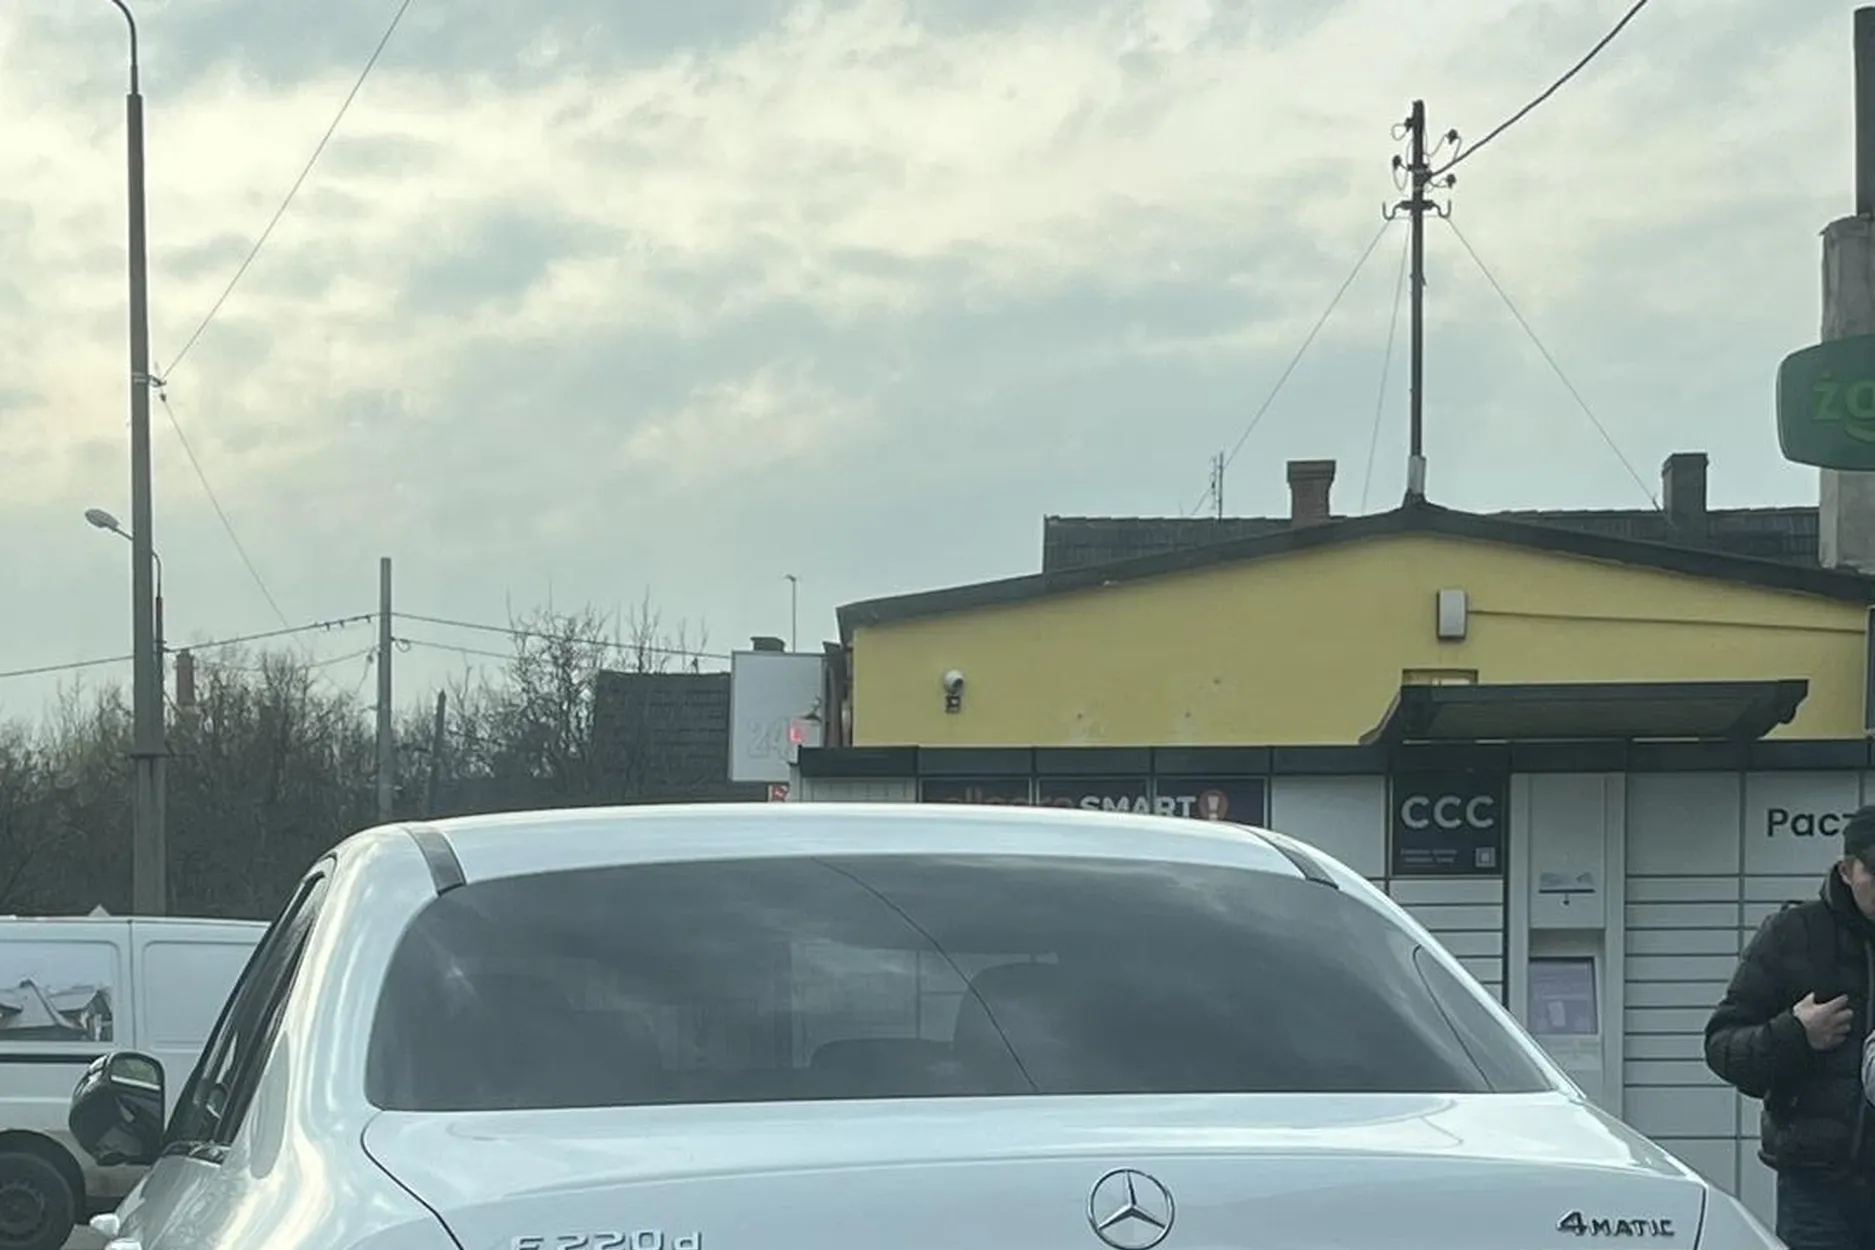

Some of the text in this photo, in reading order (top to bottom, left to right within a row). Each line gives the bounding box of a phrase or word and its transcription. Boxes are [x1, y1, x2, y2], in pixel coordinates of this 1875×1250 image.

[1401, 796, 1494, 828] CCC
[1767, 808, 1857, 836] Pac
[1557, 1210, 1675, 1236] 4MATIC
